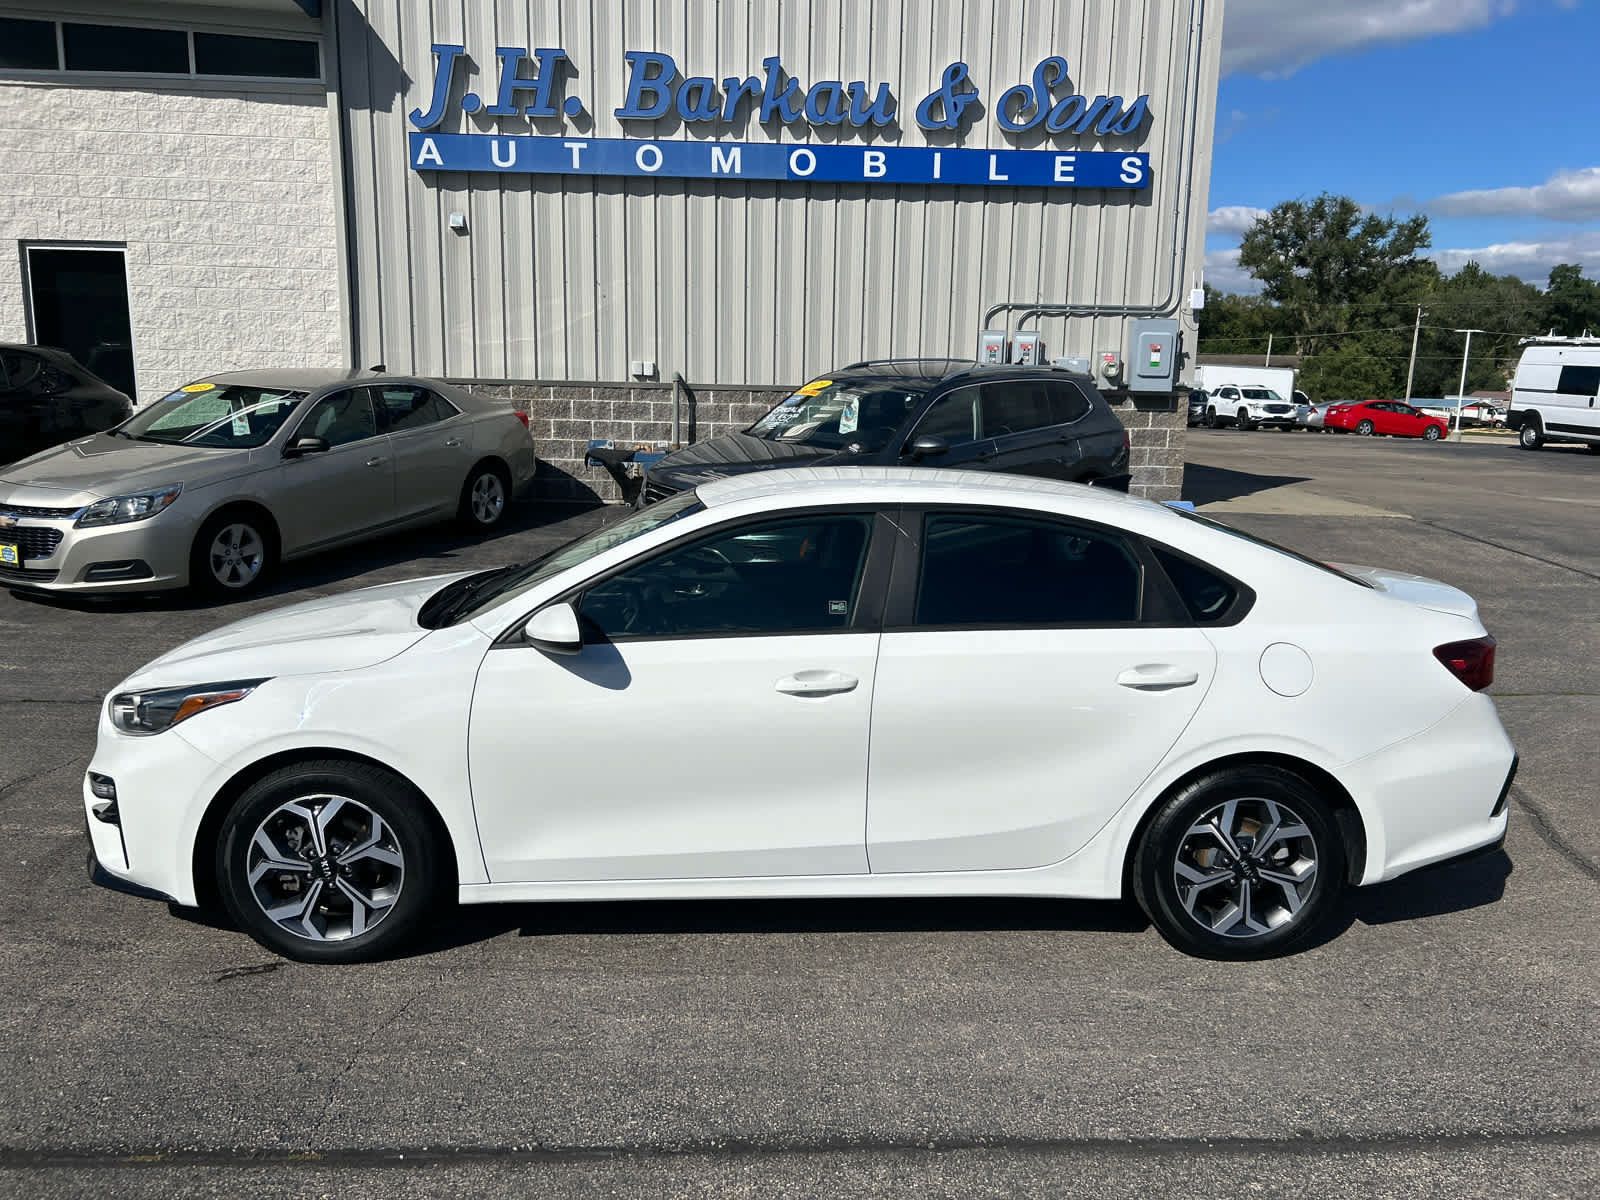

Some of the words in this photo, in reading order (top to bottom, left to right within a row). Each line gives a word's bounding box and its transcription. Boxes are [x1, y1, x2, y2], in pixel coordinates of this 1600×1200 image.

[409, 44, 582, 129] J.H.
[614, 51, 896, 128] Barkau
[916, 62, 979, 130] &
[996, 55, 1150, 136] Sons
[416, 137, 1143, 184] AUTOMOBILES
